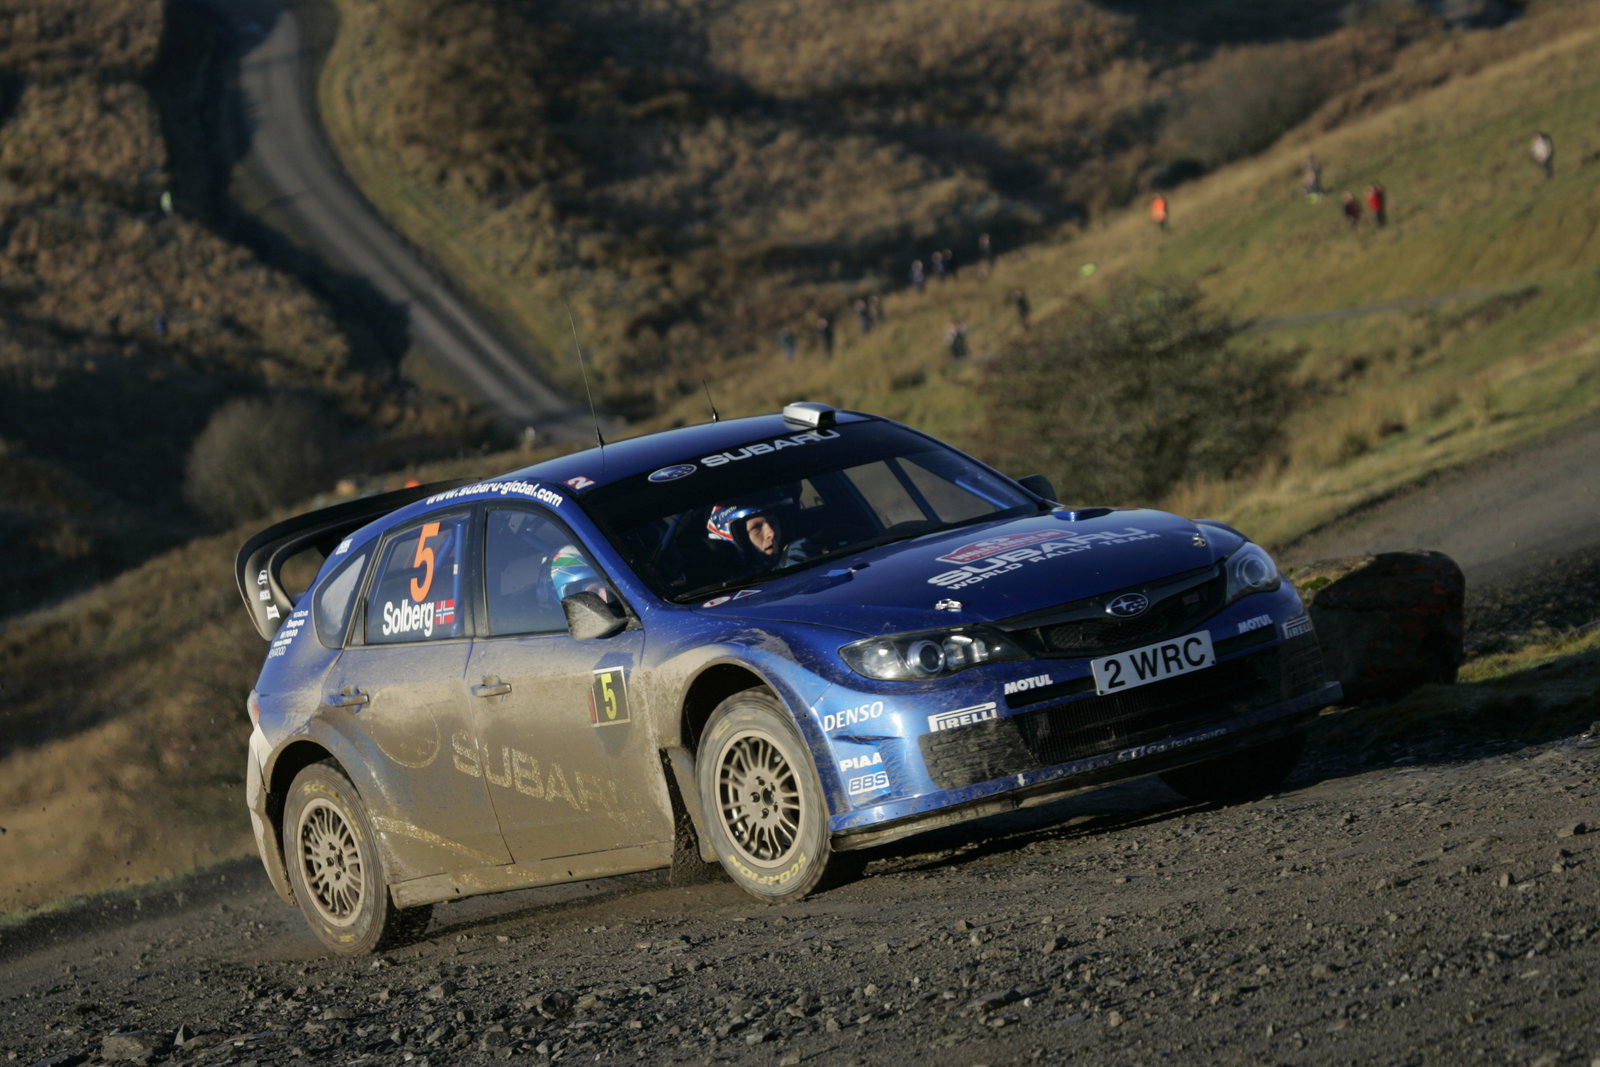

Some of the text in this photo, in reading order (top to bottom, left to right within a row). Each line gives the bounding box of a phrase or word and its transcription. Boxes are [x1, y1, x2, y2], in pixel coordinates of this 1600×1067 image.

[701, 429, 840, 467] SUBARU
[426, 480, 563, 507] www.subaru-global.com
[410, 522, 440, 602] 5
[927, 527, 1147, 586] SUBARU
[947, 562, 1023, 590] WORLD
[1028, 544, 1092, 563] RALLY
[1098, 533, 1160, 546] TEAM
[383, 599, 433, 637] Solberg
[1237, 614, 1274, 634] MOTUL
[1104, 636, 1206, 689] 2 WRC
[601, 672, 617, 720] 5
[1004, 674, 1053, 695] MOTUL
[824, 701, 884, 732] DENSO
[927, 701, 998, 733] PIRELLI
[451, 727, 652, 828] SUBAR
[839, 752, 883, 772] PIAA
[849, 771, 890, 795] BBS
